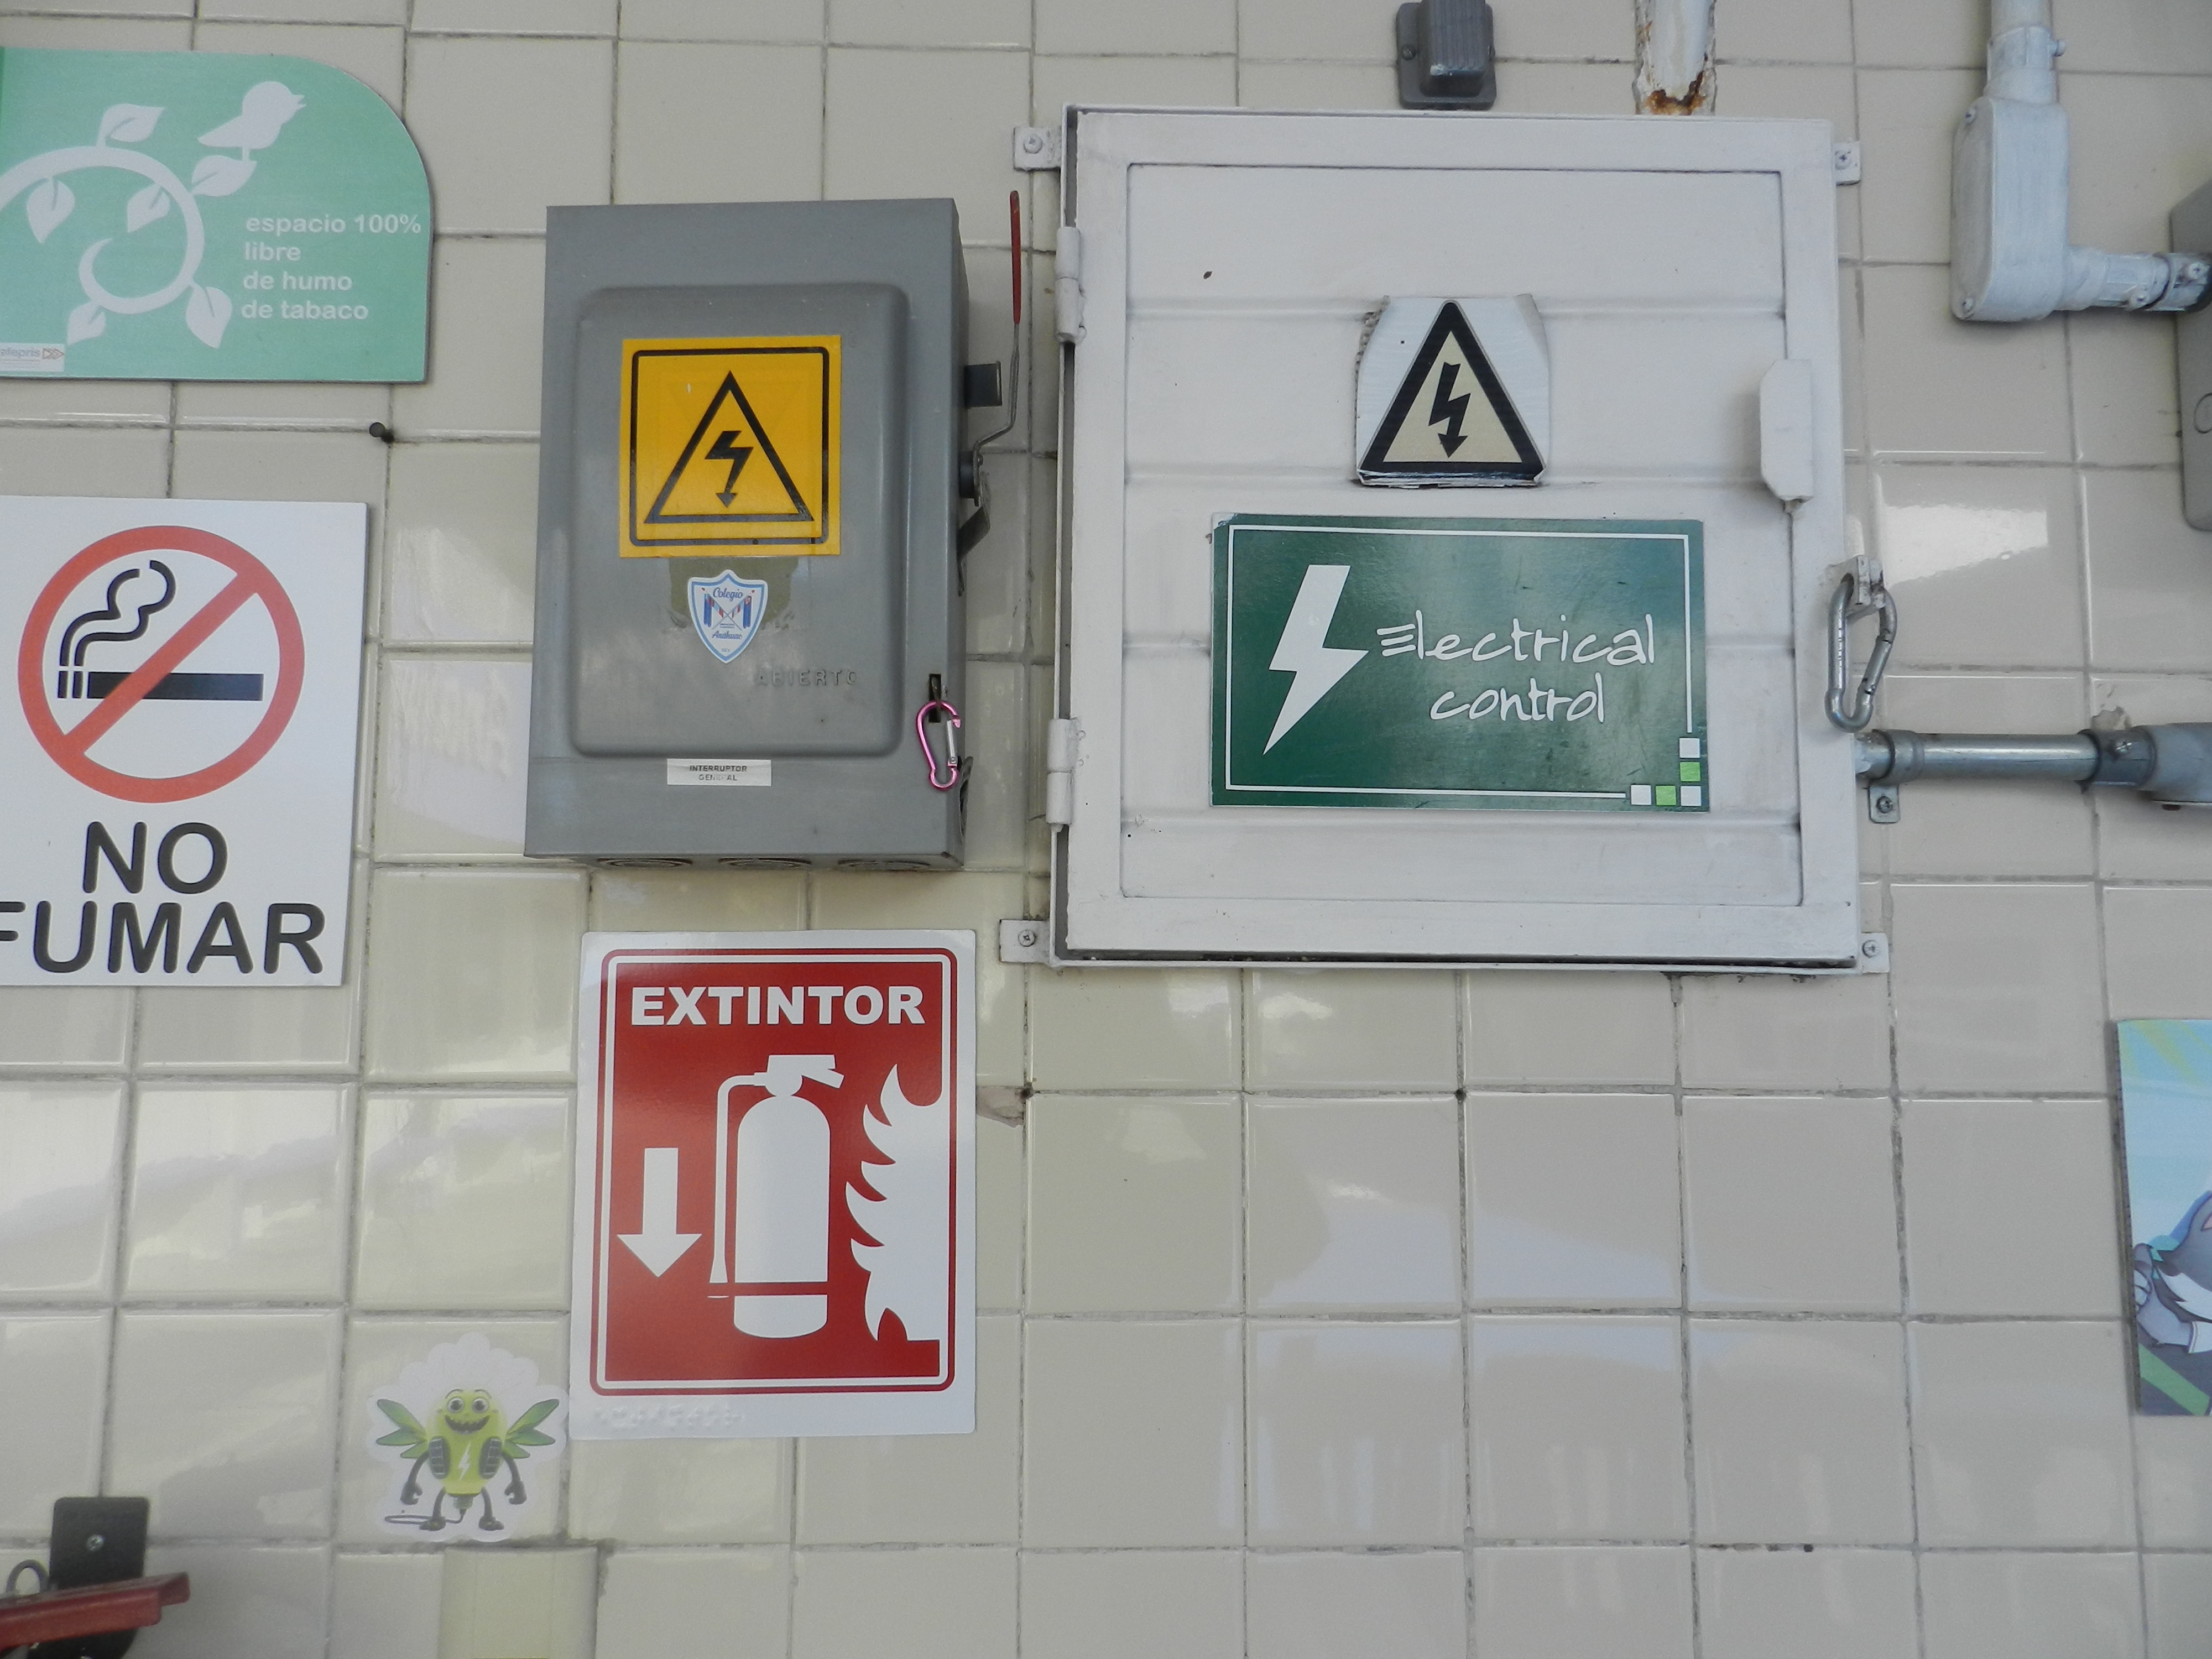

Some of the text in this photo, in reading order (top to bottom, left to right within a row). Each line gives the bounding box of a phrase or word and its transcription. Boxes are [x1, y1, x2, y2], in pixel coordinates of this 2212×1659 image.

[246, 213, 421, 237] espacio 100%
[244, 241, 302, 261] libre
[243, 270, 353, 291] de humo
[241, 300, 369, 320] de tabaco
[712, 587, 744, 602] Colegio
[1376, 609, 1655, 666] Electrical
[754, 668, 857, 686] ABIERTO
[1430, 671, 1604, 723] control
[82, 821, 228, 895] NO
[631, 985, 926, 1026] EXTINTOR
